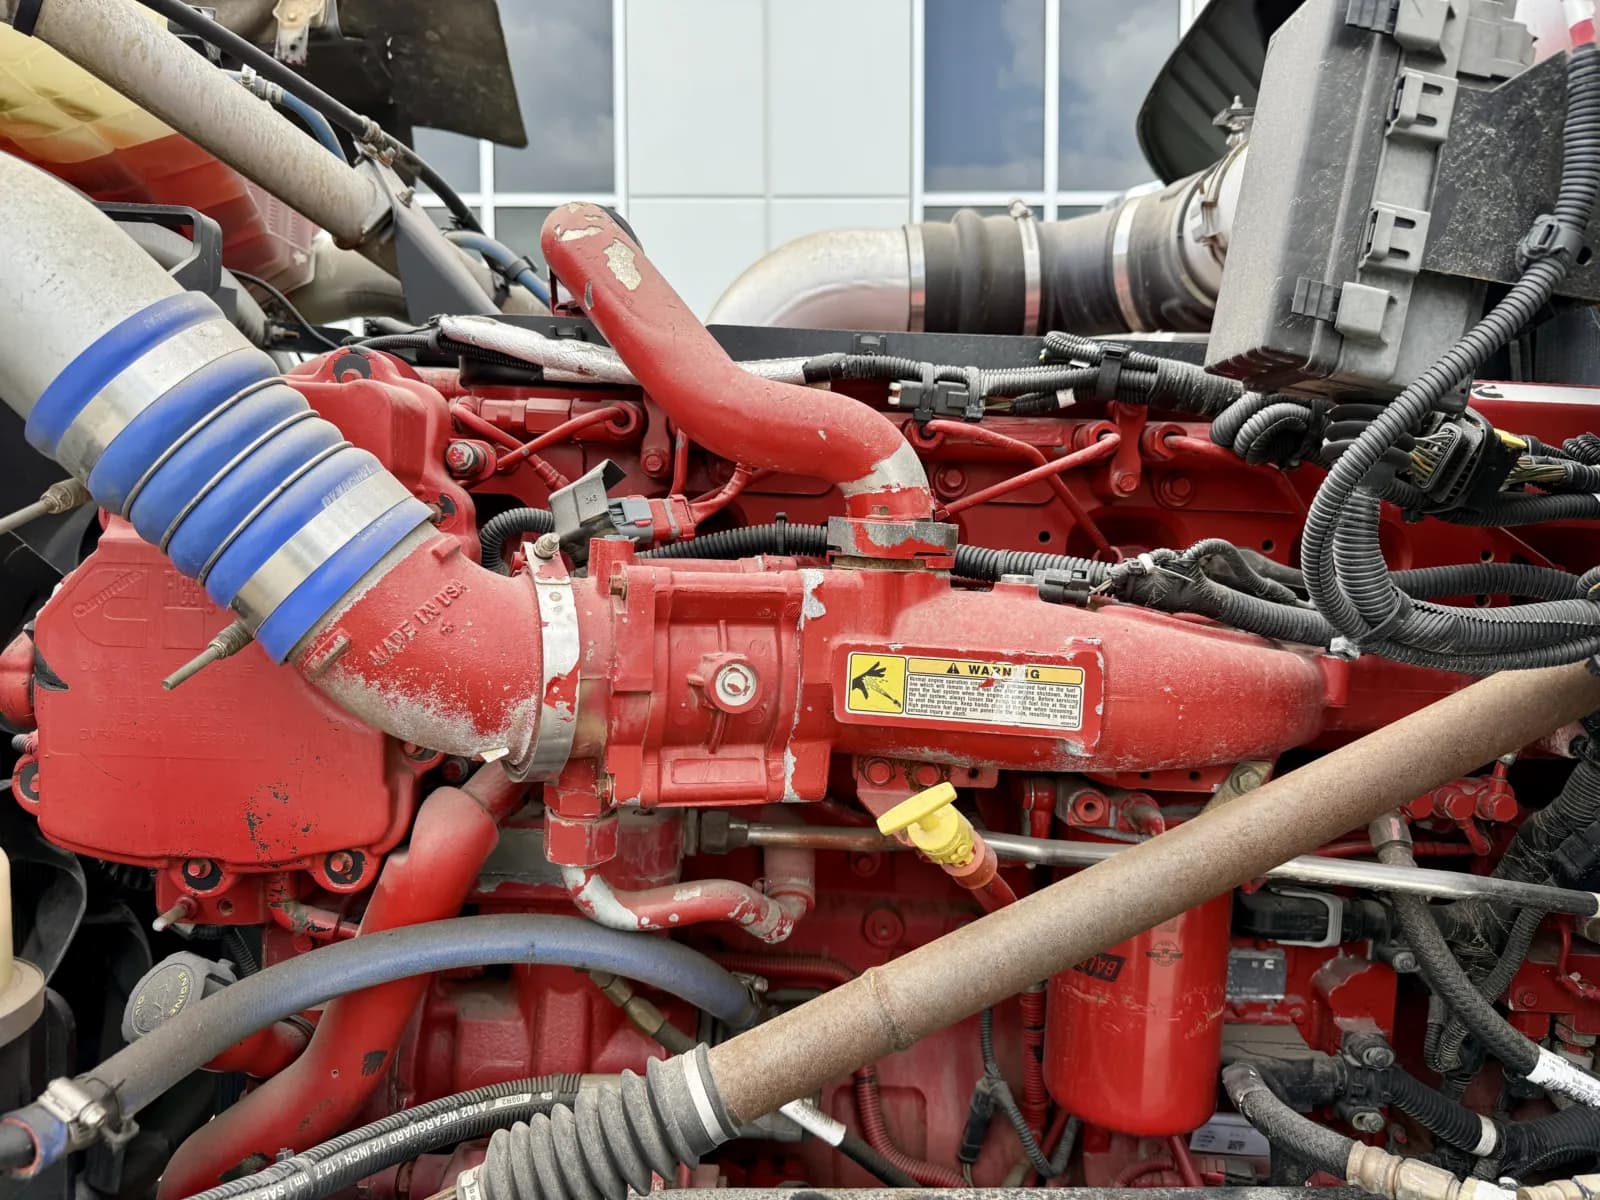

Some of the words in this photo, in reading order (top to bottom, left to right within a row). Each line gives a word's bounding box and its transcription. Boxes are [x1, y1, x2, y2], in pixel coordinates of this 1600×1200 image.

[368, 619, 418, 666] MADE
[414, 600, 441, 625] IN
[434, 579, 471, 607] USA
[168, 970, 188, 1017] ENGINE
[462, 1101, 487, 1119] A102
[389, 1110, 460, 1145] WEARGUARD
[343, 1146, 370, 1166] INCH
[372, 1139, 386, 1154] 1/2
[260, 1184, 285, 1200] SAE
